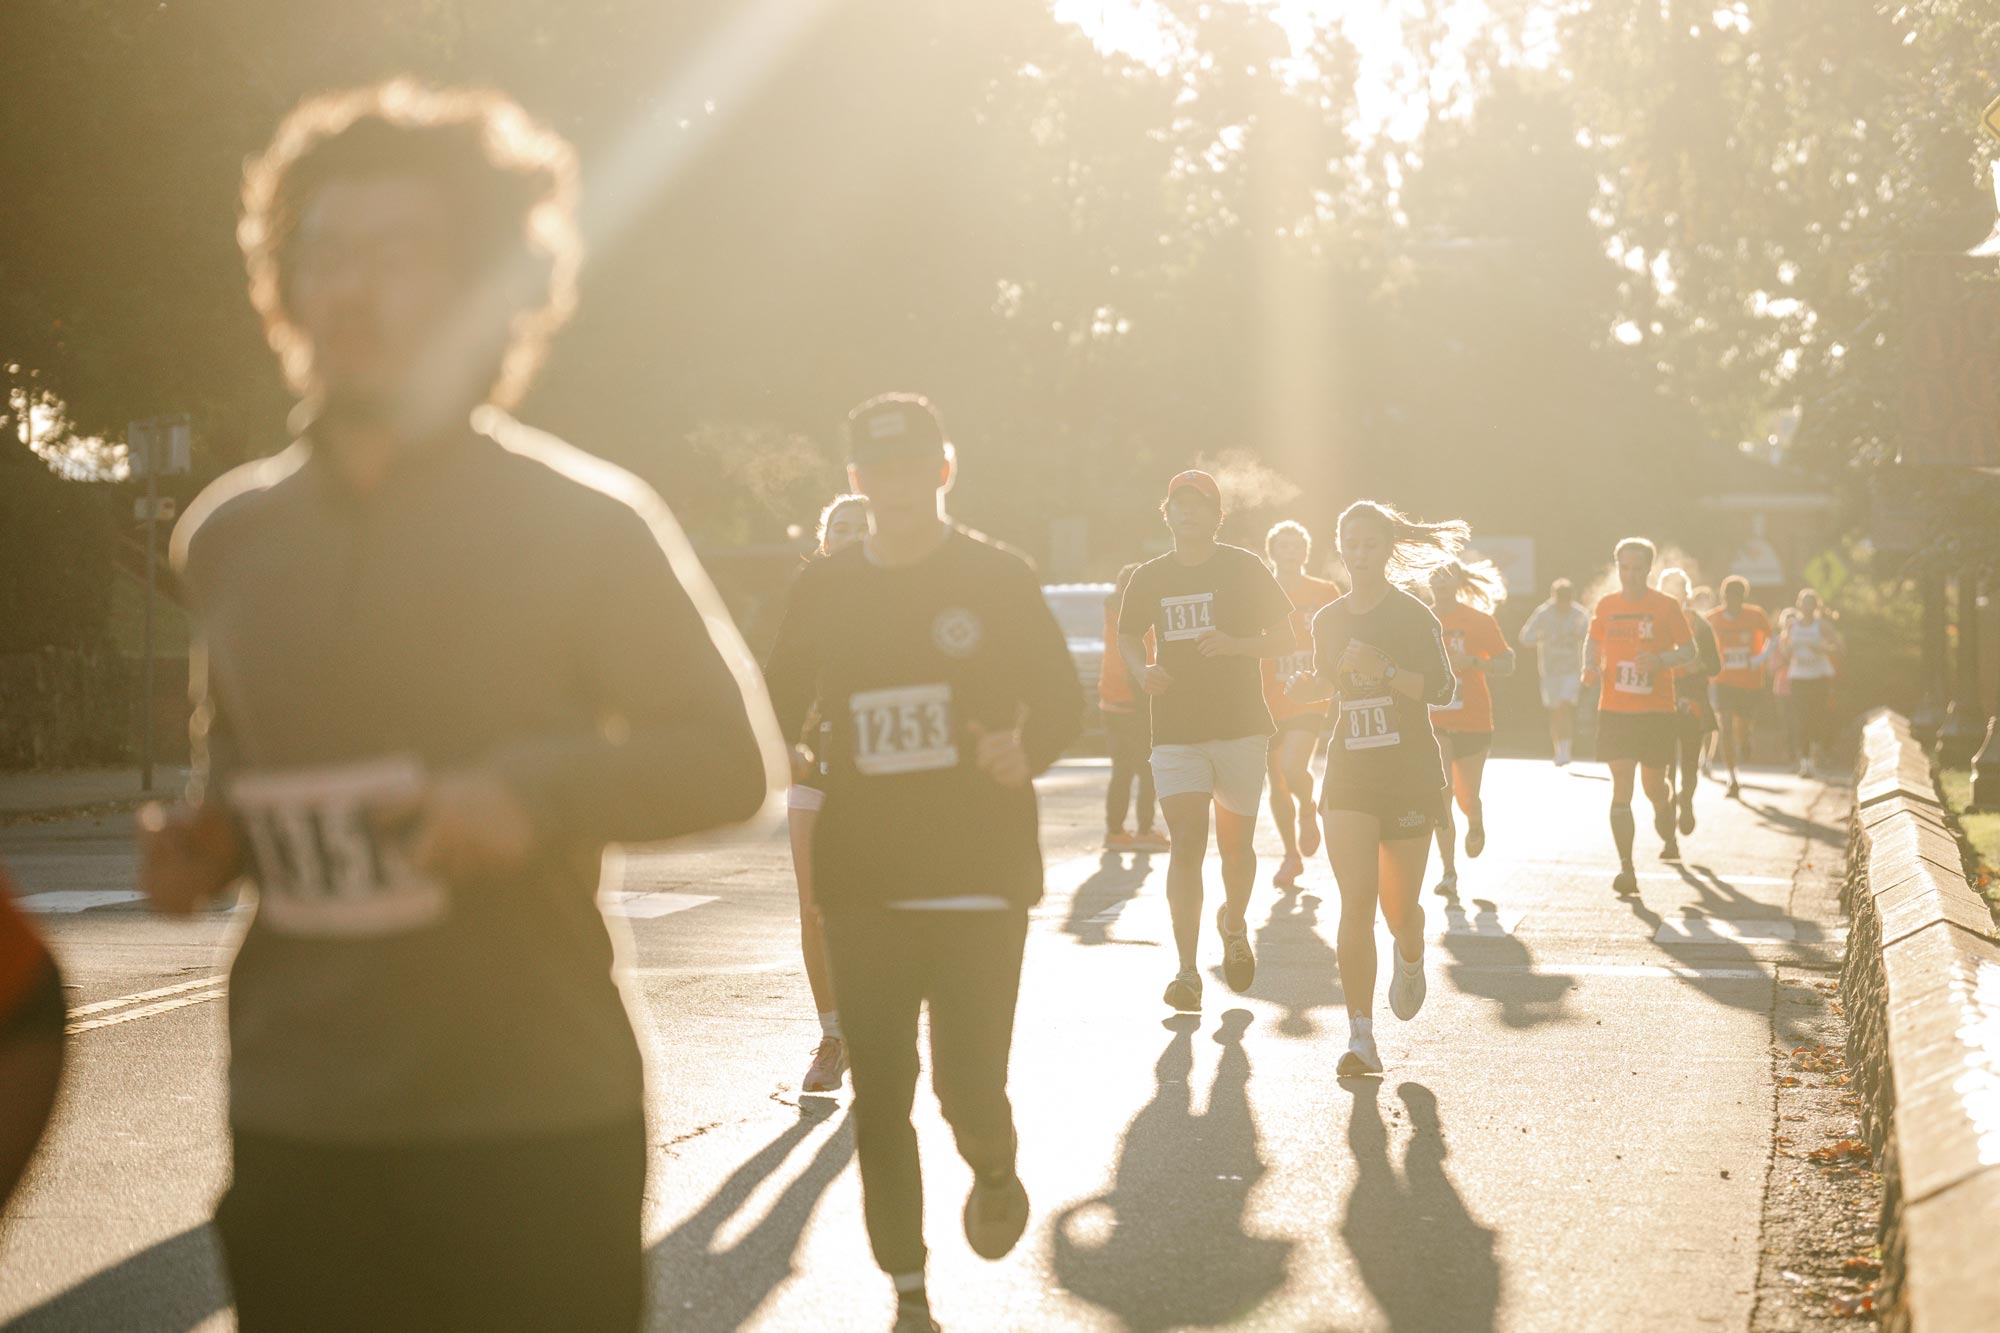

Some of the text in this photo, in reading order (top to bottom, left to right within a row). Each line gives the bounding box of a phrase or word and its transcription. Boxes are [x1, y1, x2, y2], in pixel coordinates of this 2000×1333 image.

[1165, 602, 1210, 630] 1314
[1638, 621, 1654, 640] 5K
[1449, 636, 1465, 654] 5K
[855, 702, 949, 755] 1253
[1349, 706, 1388, 738] 879
